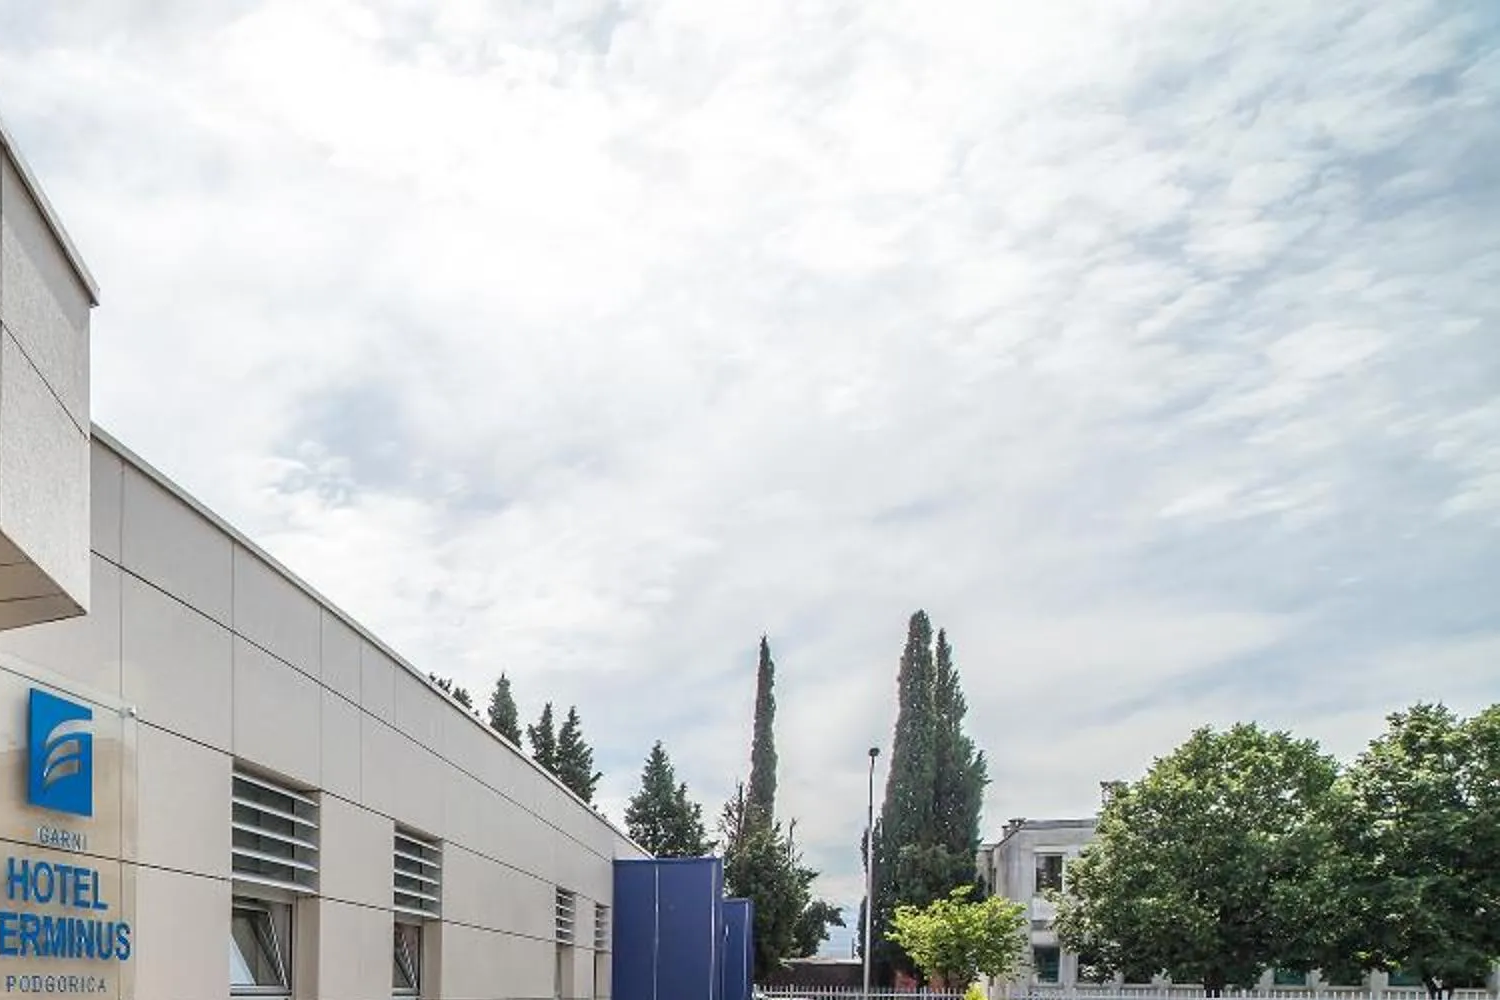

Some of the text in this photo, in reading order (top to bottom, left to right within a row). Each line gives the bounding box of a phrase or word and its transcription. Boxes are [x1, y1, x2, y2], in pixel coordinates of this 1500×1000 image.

[39, 825, 87, 851] GARNI
[7, 857, 108, 910] HOTEL
[5, 975, 107, 993] PODGORICA
